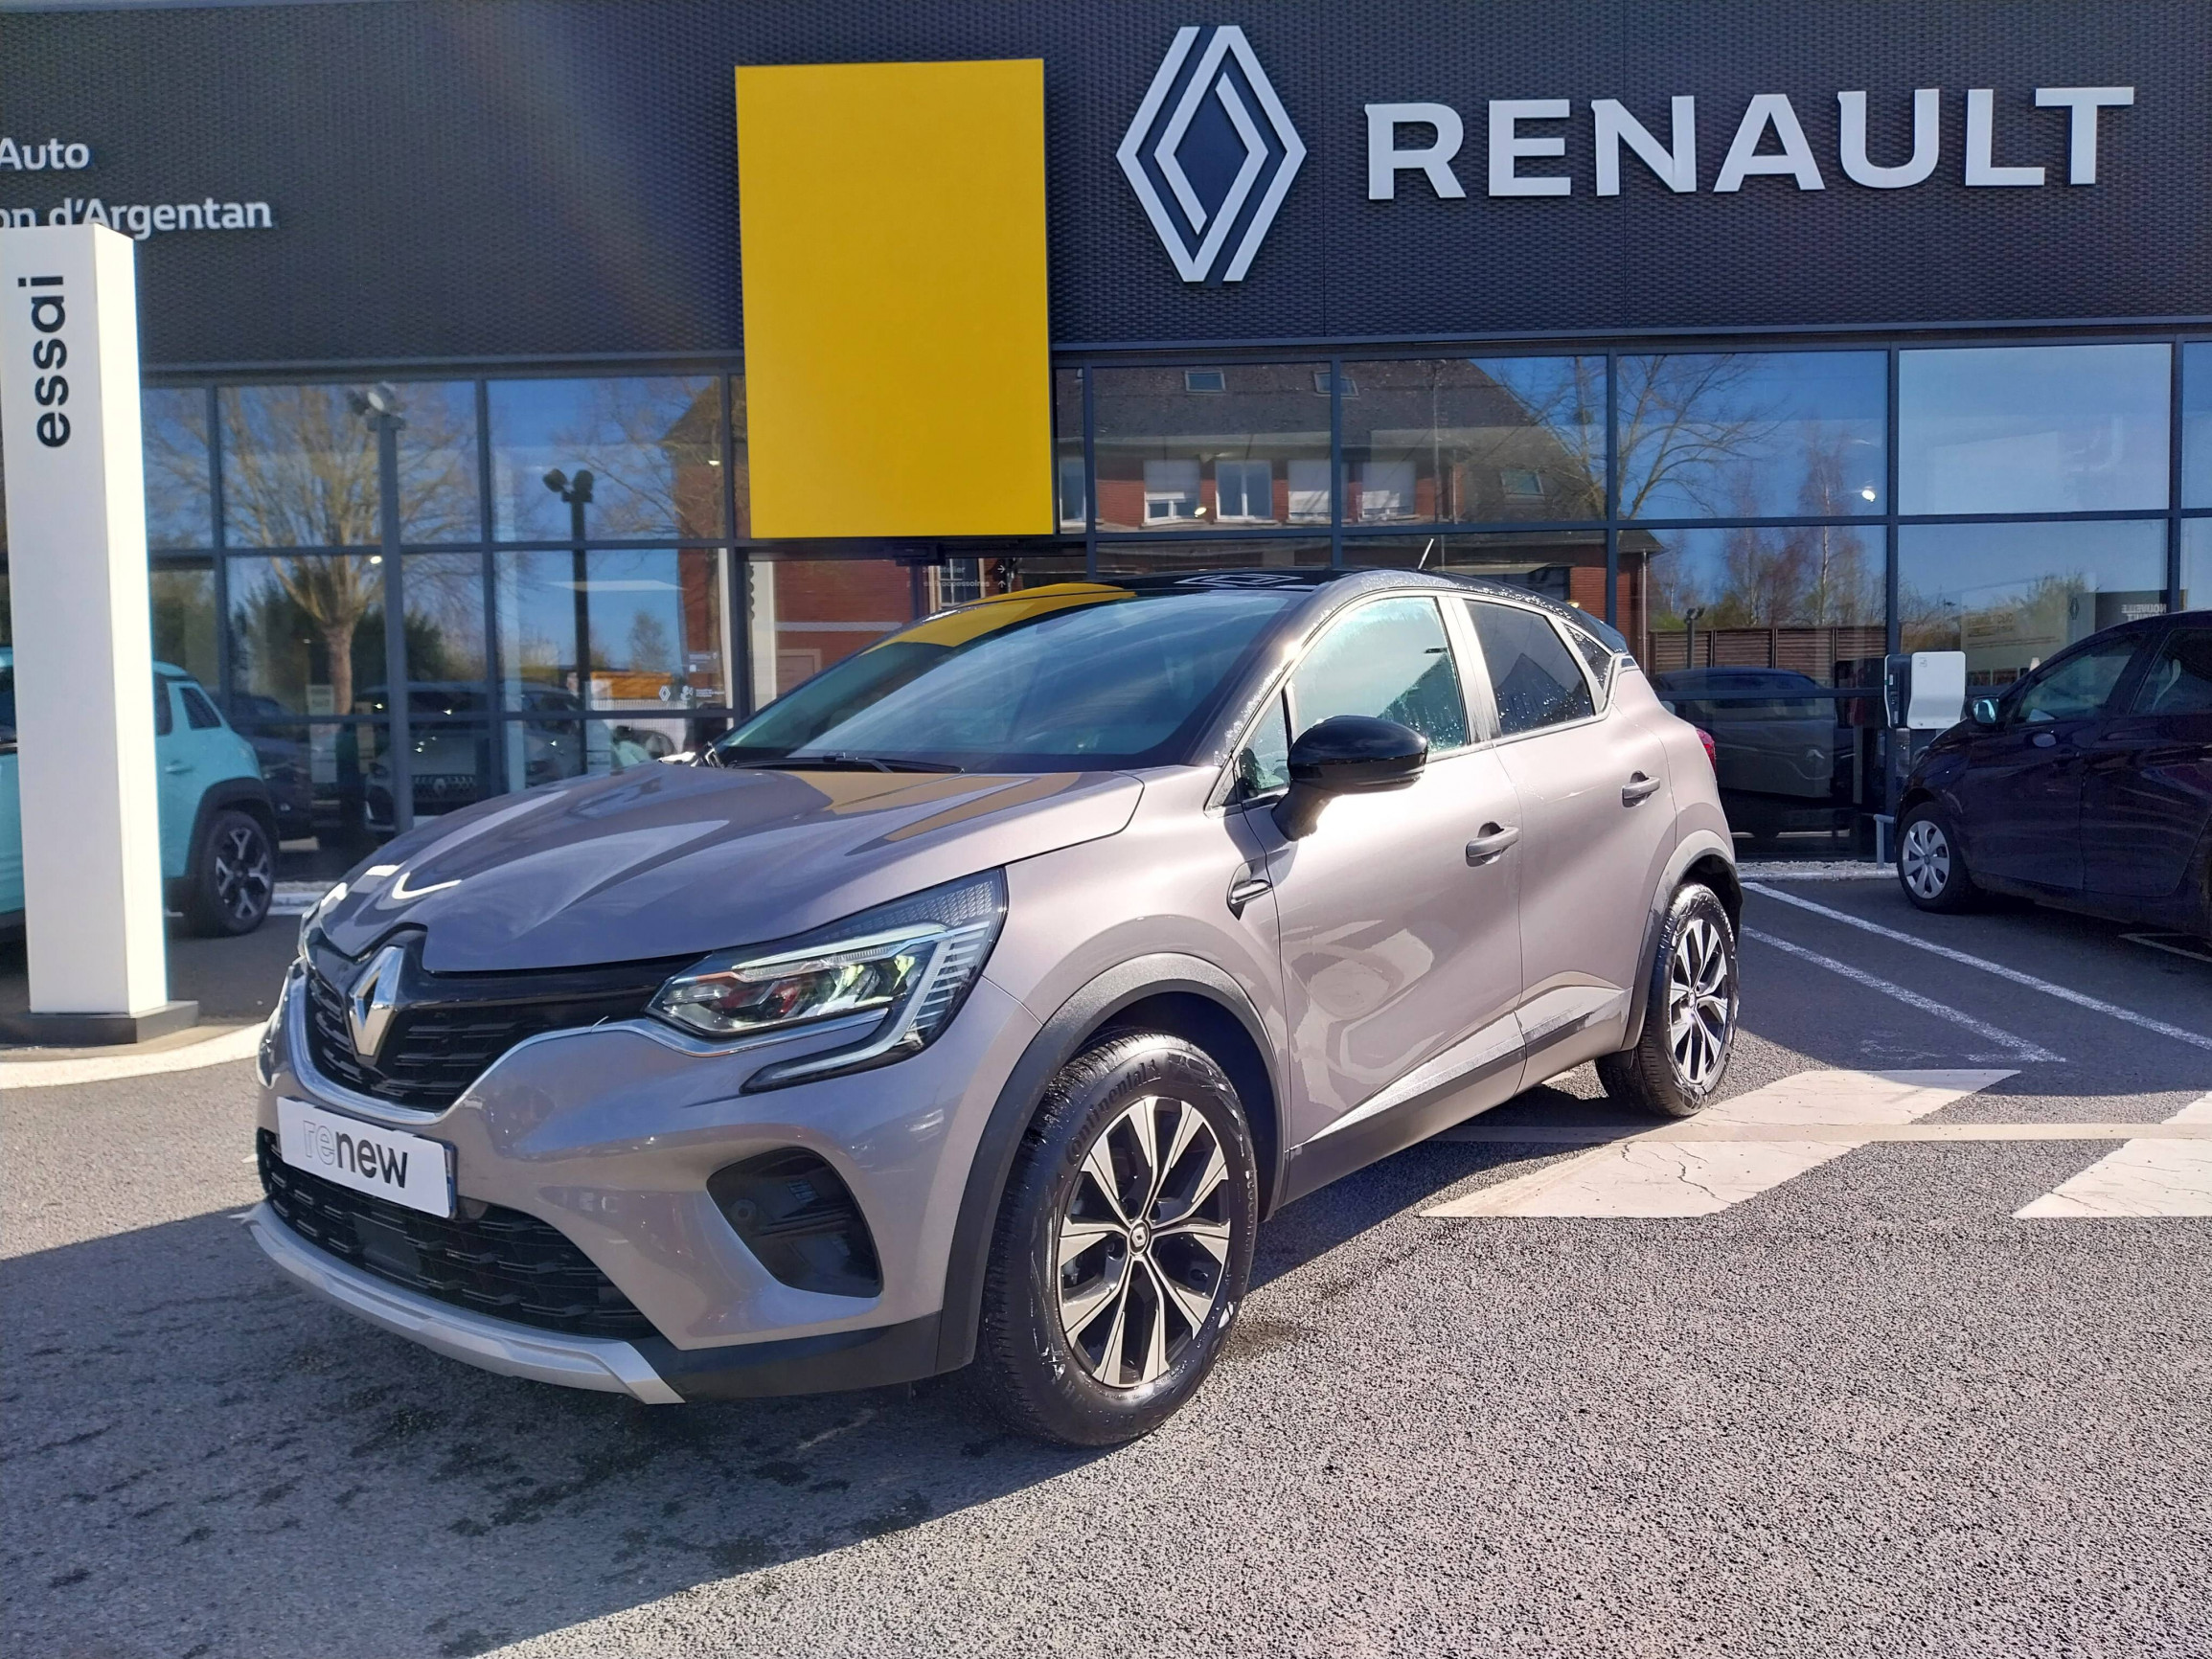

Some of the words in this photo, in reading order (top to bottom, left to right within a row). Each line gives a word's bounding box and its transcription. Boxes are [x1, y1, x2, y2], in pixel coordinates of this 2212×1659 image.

[0, 137, 91, 170] Auto
[1364, 86, 2135, 200] RENAULT
[49, 197, 273, 239] d'Argentan
[17, 275, 72, 447] essai
[302, 1120, 409, 1189] renew
[1065, 1061, 1148, 1167] Continental
